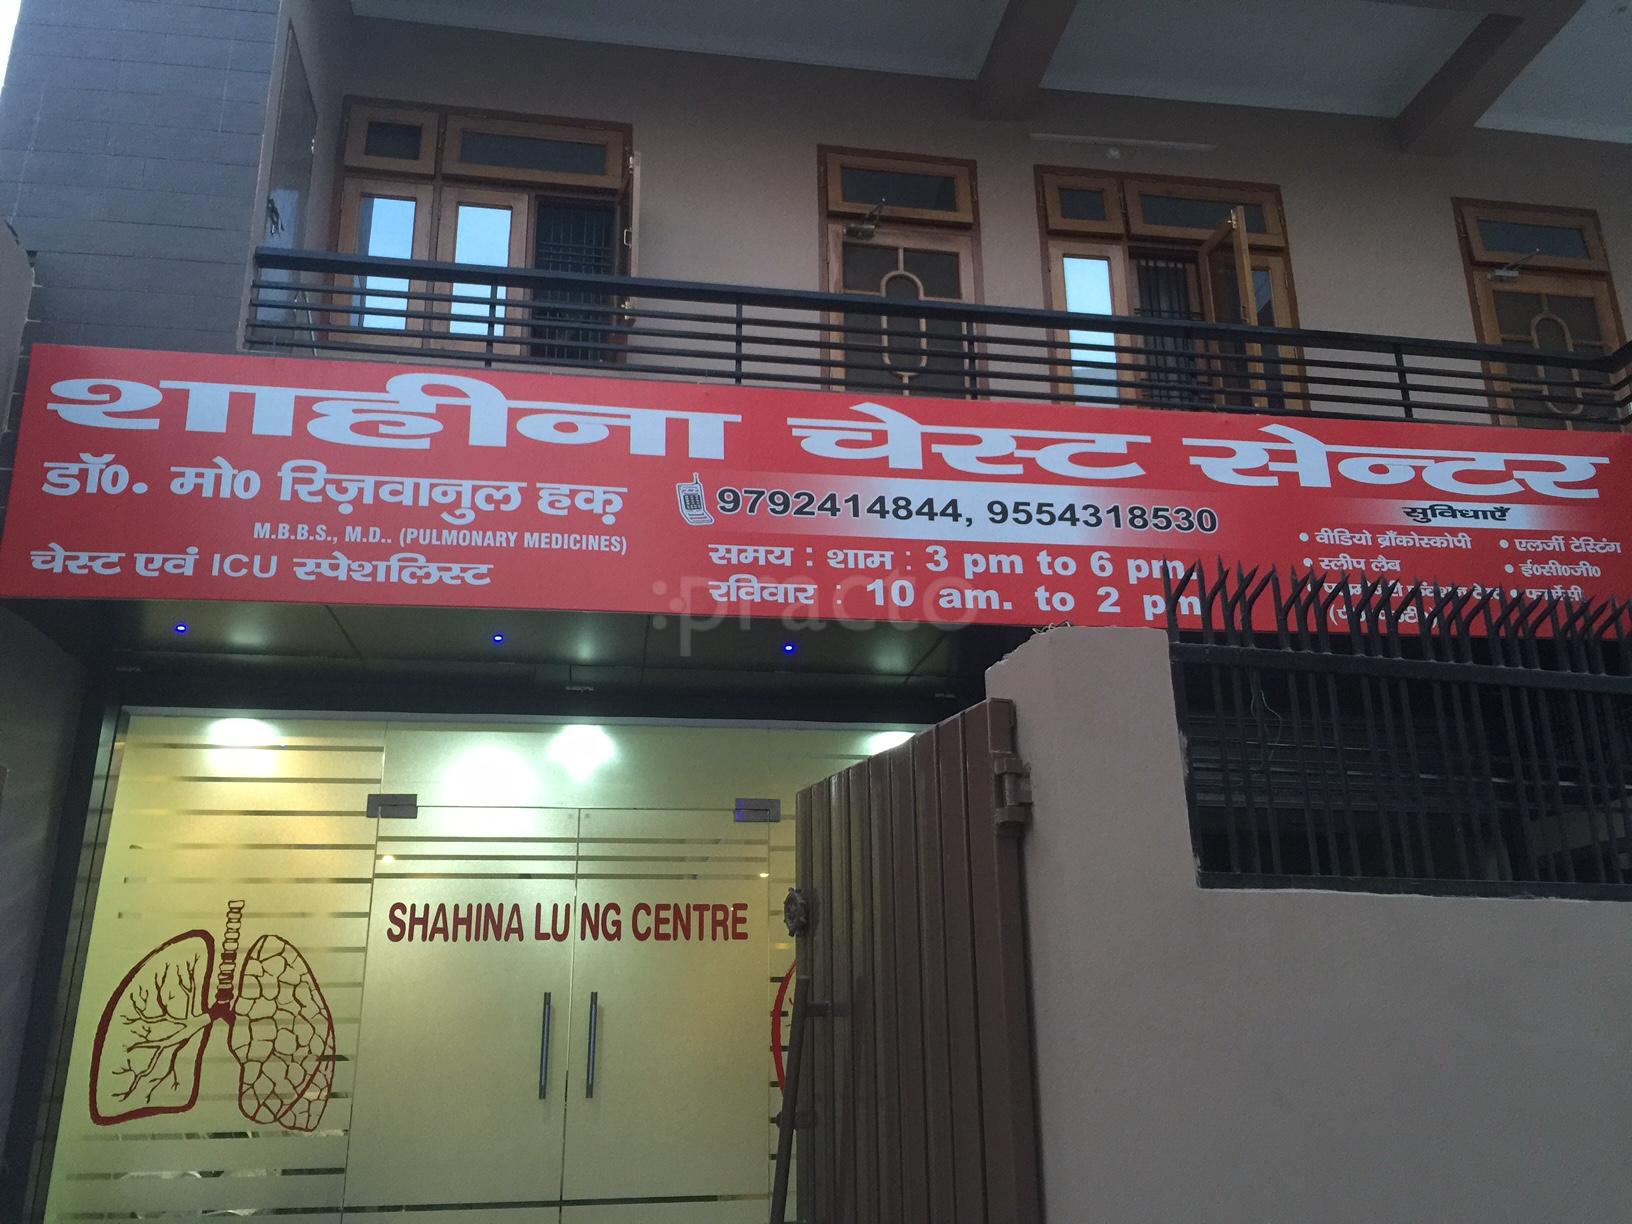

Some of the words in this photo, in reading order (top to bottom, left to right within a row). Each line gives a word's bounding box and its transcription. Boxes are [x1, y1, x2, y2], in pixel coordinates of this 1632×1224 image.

[47, 373, 742, 460] शाहीना
[786, 401, 1152, 480] चेस्ट
[1182, 424, 1610, 499] सेन्टर
[278, 459, 527, 526] रिज़वानुल
[536, 483, 628, 526] हक़
[987, 499, 1219, 534] 9554318530
[253, 522, 338, 544] M.B.B.S.,
[400, 528, 518, 548] (PULMONARY
[524, 532, 628, 555] MEDICINES)
[1314, 527, 1373, 546] वीडियो
[1514, 535, 1566, 552] एलर्जी
[30, 542, 127, 576] चेस्ट
[134, 546, 200, 577] एवं
[212, 553, 278, 578] ICU
[708, 544, 794, 567] समय
[827, 549, 894, 570] शाम
[925, 545, 949, 572] 3
[963, 552, 1024, 579] pm
[1036, 550, 1077, 576] to
[1089, 551, 1114, 577] 6
[1318, 553, 1366, 570] स्लीप
[708, 574, 818, 605] रविवार
[866, 579, 915, 607] 10
[938, 587, 1013, 610] am.
[1034, 585, 1075, 611] to
[1096, 587, 1121, 613] 2
[386, 902, 524, 942] SHAHINA
[632, 902, 749, 942] CENTRE
